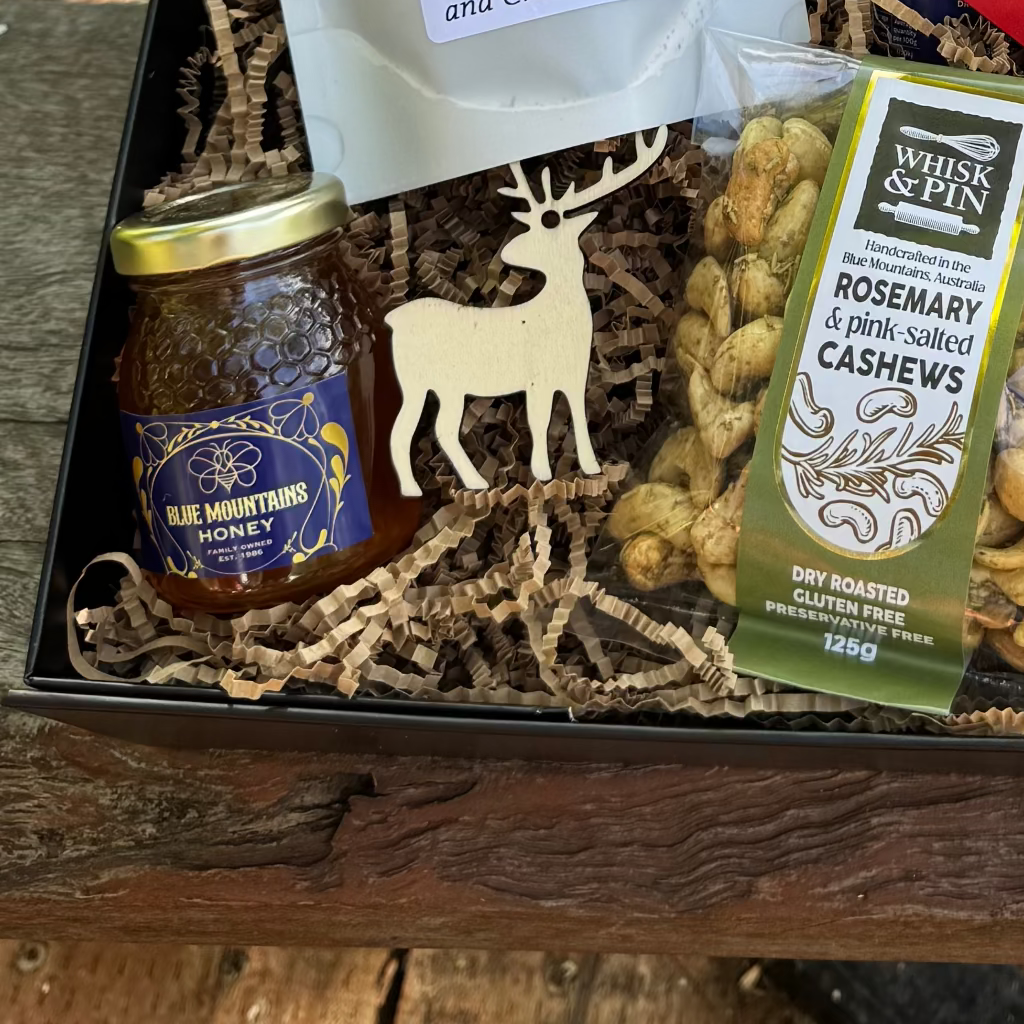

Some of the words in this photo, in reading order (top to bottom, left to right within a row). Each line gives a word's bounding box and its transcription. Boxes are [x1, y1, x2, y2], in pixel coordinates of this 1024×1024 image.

[894, 143, 996, 189] WHISK
[920, 176, 990, 216] PIN
[842, 251, 868, 268] Blue
[869, 256, 932, 283] Mountains,
[934, 271, 986, 294] Australia
[865, 238, 937, 266] Handcrafted
[939, 257, 950, 270] in
[952, 259, 972, 274] the
[833, 272, 983, 326] ROSEMARY
[825, 306, 843, 331] &
[845, 312, 975, 356] pink-salted
[817, 340, 966, 395] CASHEWS
[166, 504, 203, 527] BLUE
[204, 481, 309, 525] MOUNTAINS
[199, 517, 274, 543] HONEY
[207, 545, 238, 556] FAMILY
[240, 538, 273, 550] OWNED
[240, 548, 264, 560] 1986
[792, 565, 827, 588] DRY
[830, 574, 910, 606] ROASTED
[765, 600, 888, 636] PRESERVATIVE
[891, 628, 935, 646] FREE
[793, 588, 859, 616] GLUTEN
[862, 604, 906, 626] FREE
[824, 632, 877, 662] 125g
